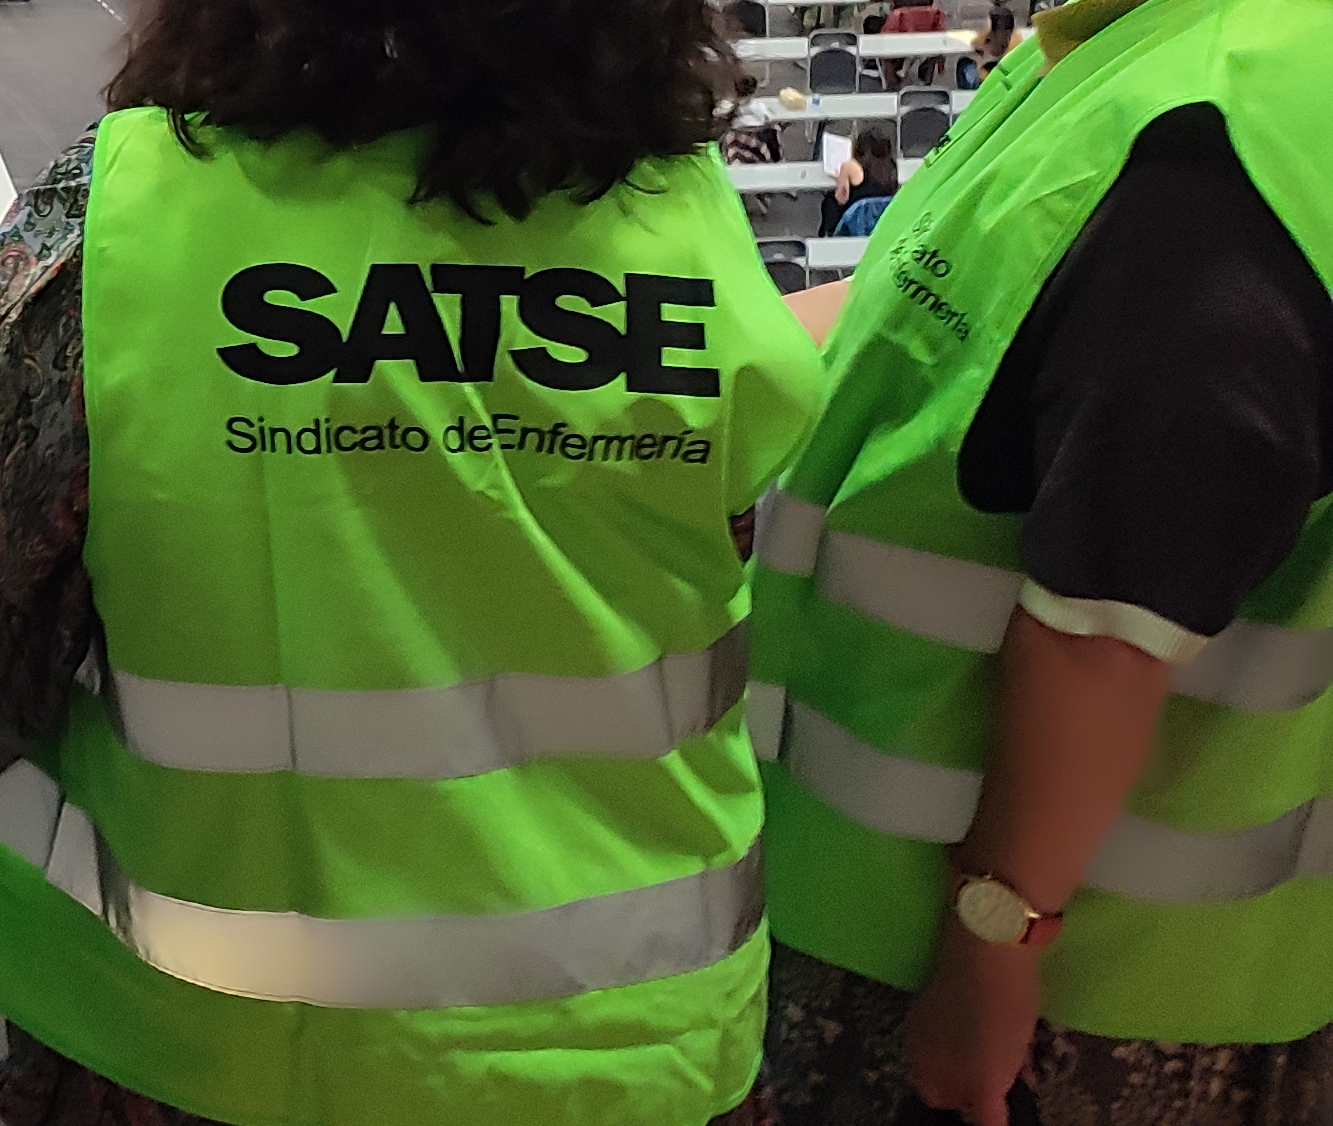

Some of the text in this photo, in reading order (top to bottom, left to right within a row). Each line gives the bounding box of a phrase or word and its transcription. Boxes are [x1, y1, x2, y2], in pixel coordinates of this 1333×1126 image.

[215, 261, 721, 398] SATSE
[226, 413, 713, 464] Sindicato de Enfermería
